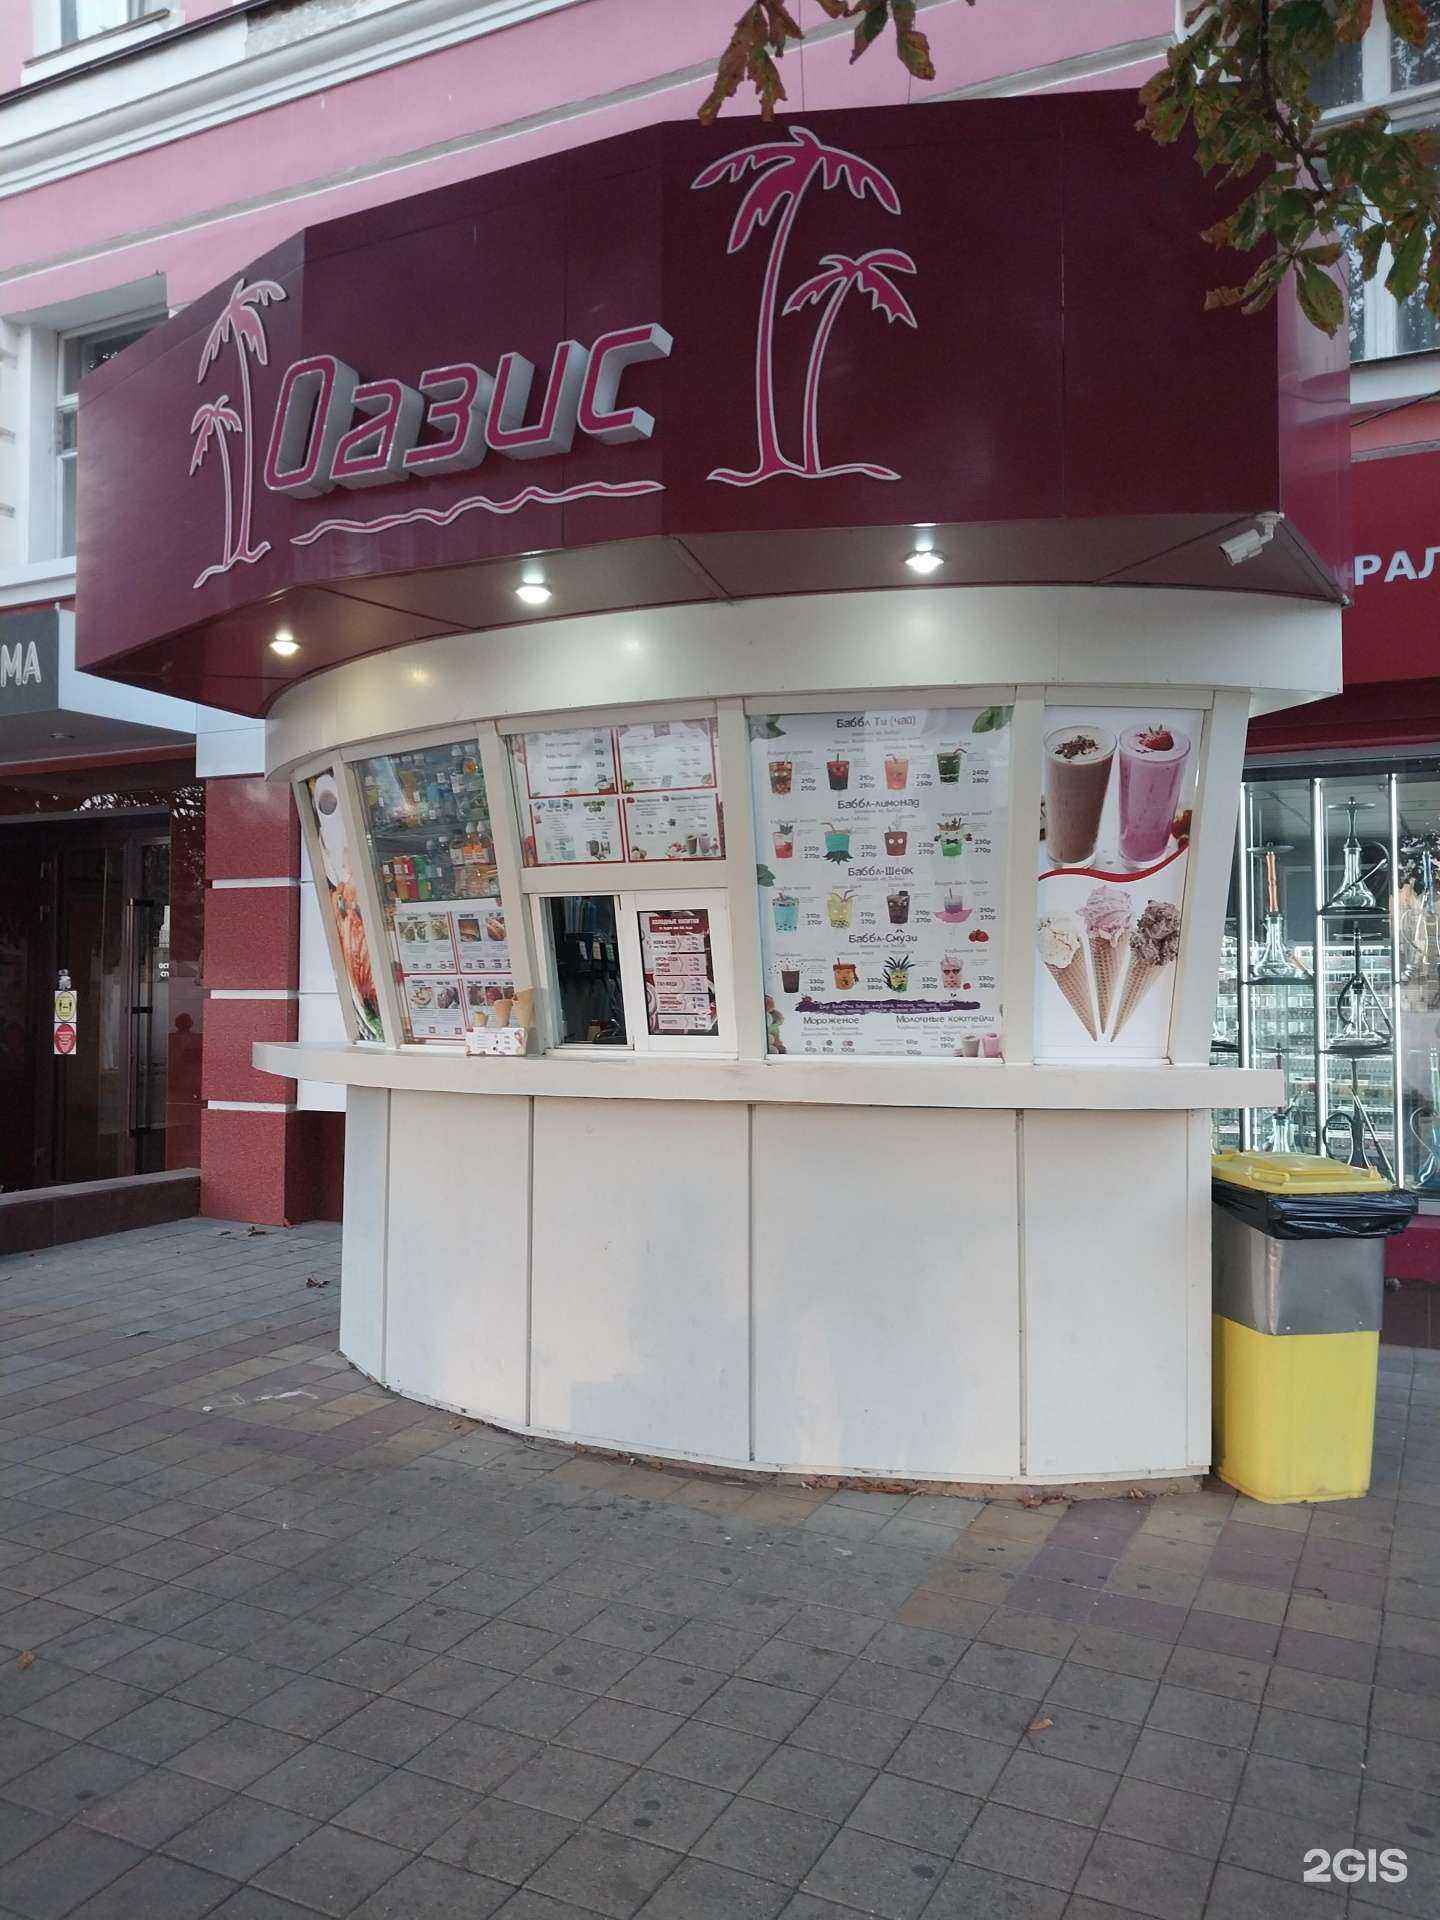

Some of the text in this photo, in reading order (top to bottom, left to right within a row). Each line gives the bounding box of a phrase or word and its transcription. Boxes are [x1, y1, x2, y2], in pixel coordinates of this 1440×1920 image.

[0, 641, 41, 687] МА
[836, 716, 871, 729] Баббл
[838, 798, 920, 810] Баббл-лимонад
[848, 865, 914, 877] Баббл-Шейк
[849, 932, 919, 945] Баббл-Смузи
[803, 1016, 860, 1025] Мороженое
